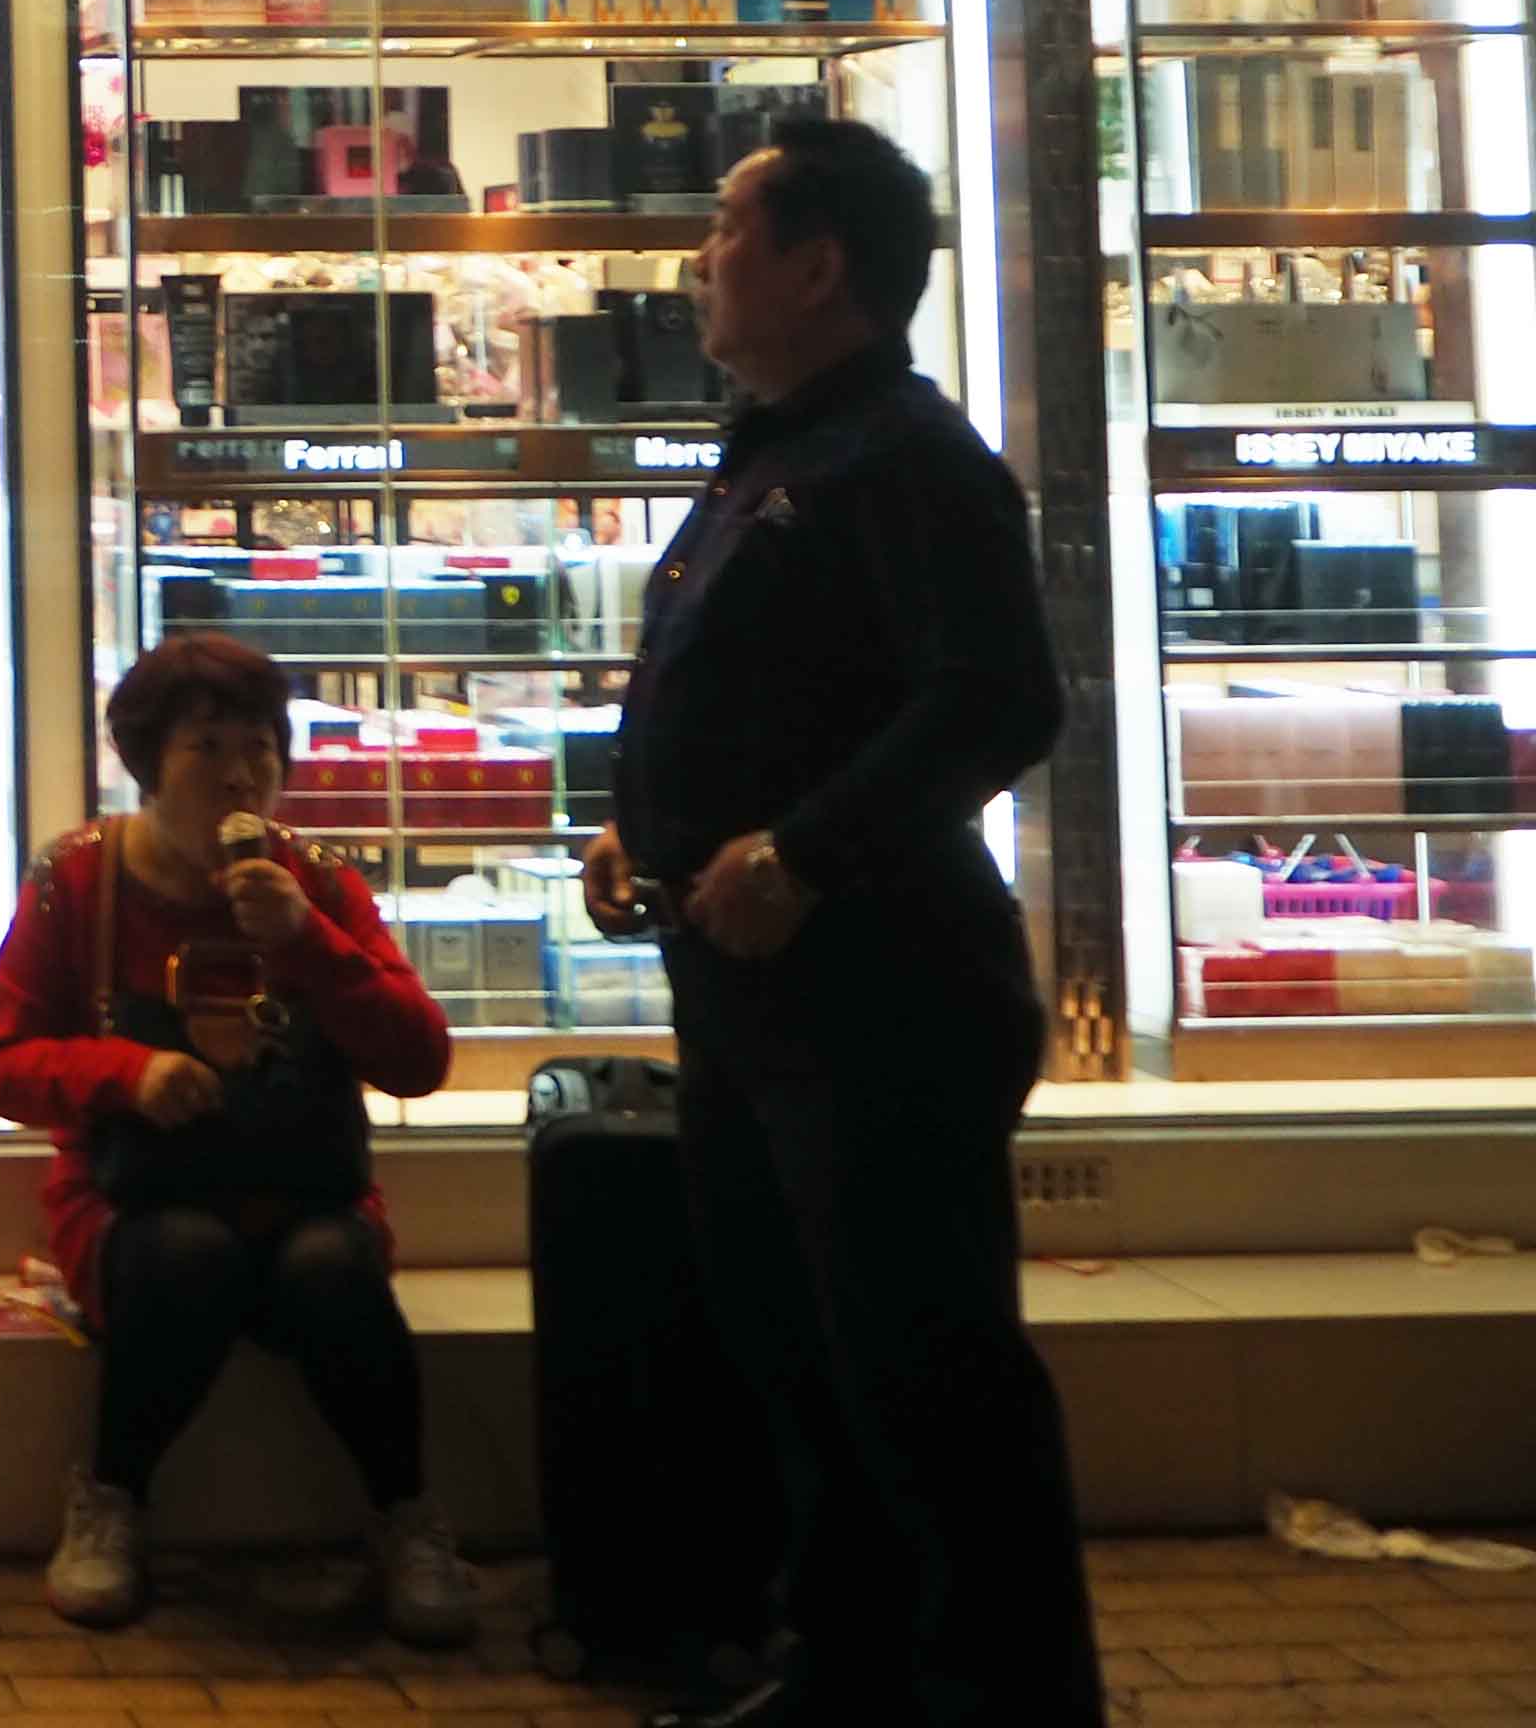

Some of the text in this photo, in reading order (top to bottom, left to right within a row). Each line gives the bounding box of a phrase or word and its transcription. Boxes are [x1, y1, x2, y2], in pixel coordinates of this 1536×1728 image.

[283, 440, 404, 471] Ferrari
[1235, 432, 1476, 463] ISSEY MIYAKE
